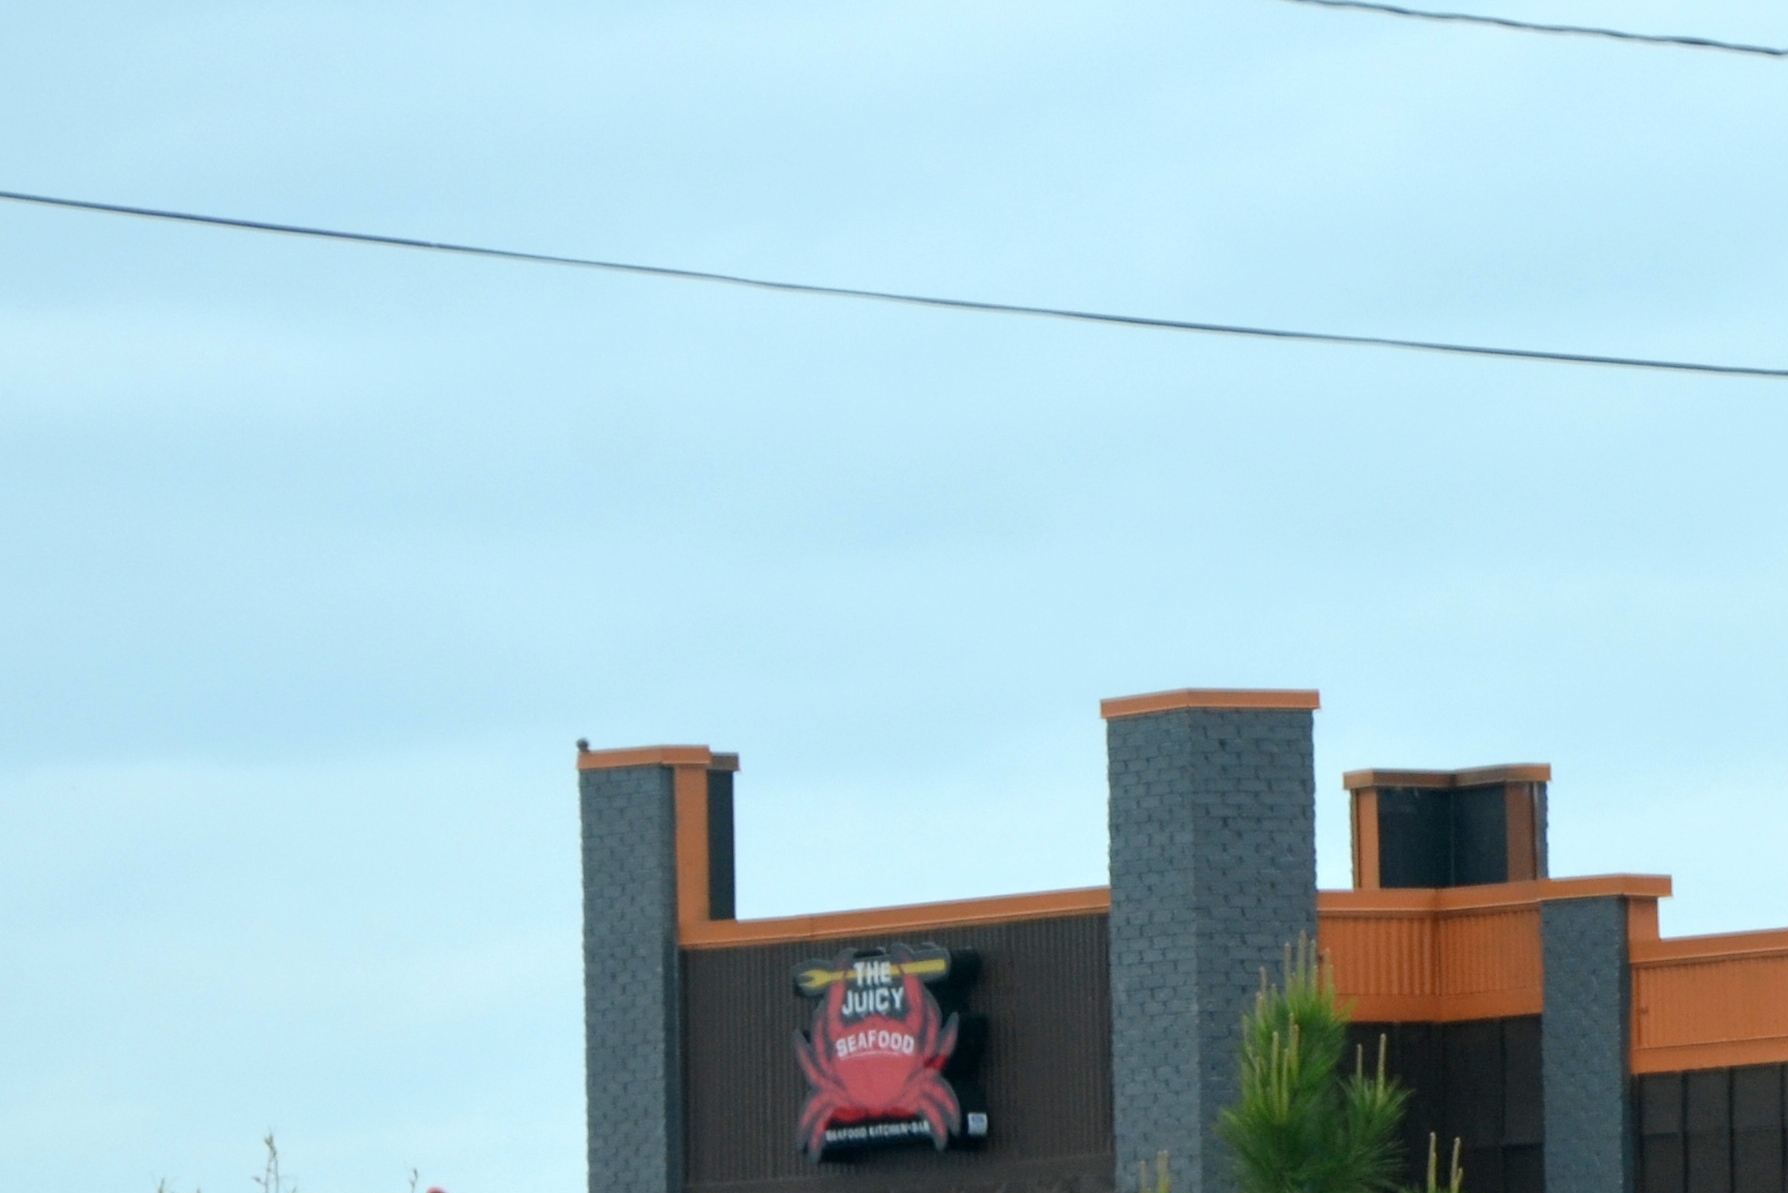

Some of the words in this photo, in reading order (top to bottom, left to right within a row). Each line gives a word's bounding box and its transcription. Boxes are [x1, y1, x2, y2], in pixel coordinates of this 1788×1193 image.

[853, 961, 892, 986] THE
[842, 987, 905, 1015] JUICY
[835, 1029, 916, 1057] SEAFOOD
